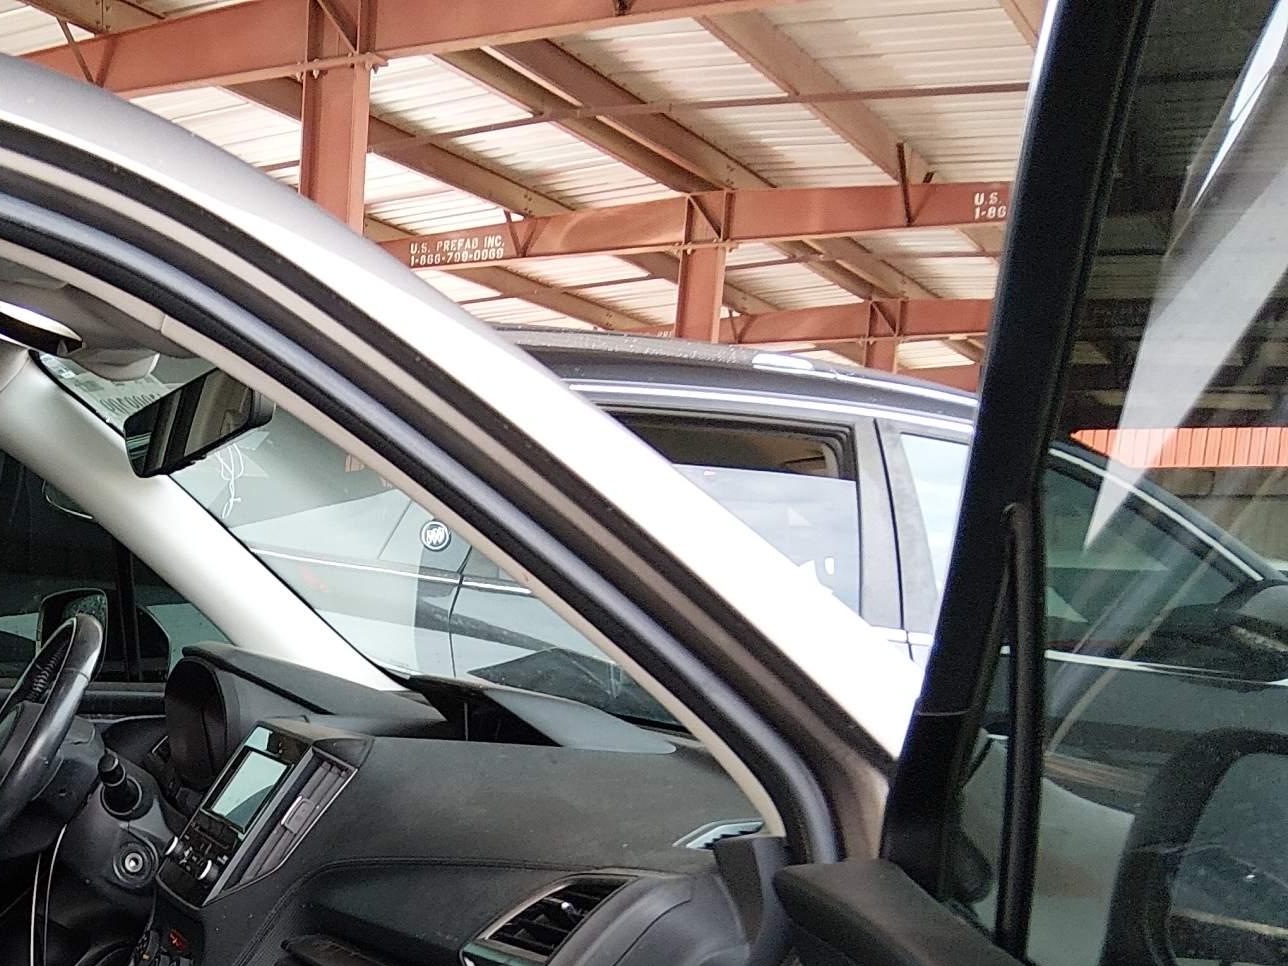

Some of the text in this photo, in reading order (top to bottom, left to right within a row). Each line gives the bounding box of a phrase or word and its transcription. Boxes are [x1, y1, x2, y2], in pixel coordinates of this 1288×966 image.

[974, 192, 1001, 205] U.S.
[410, 242, 430, 254] U.S.
[484, 235, 504, 248] INC.
